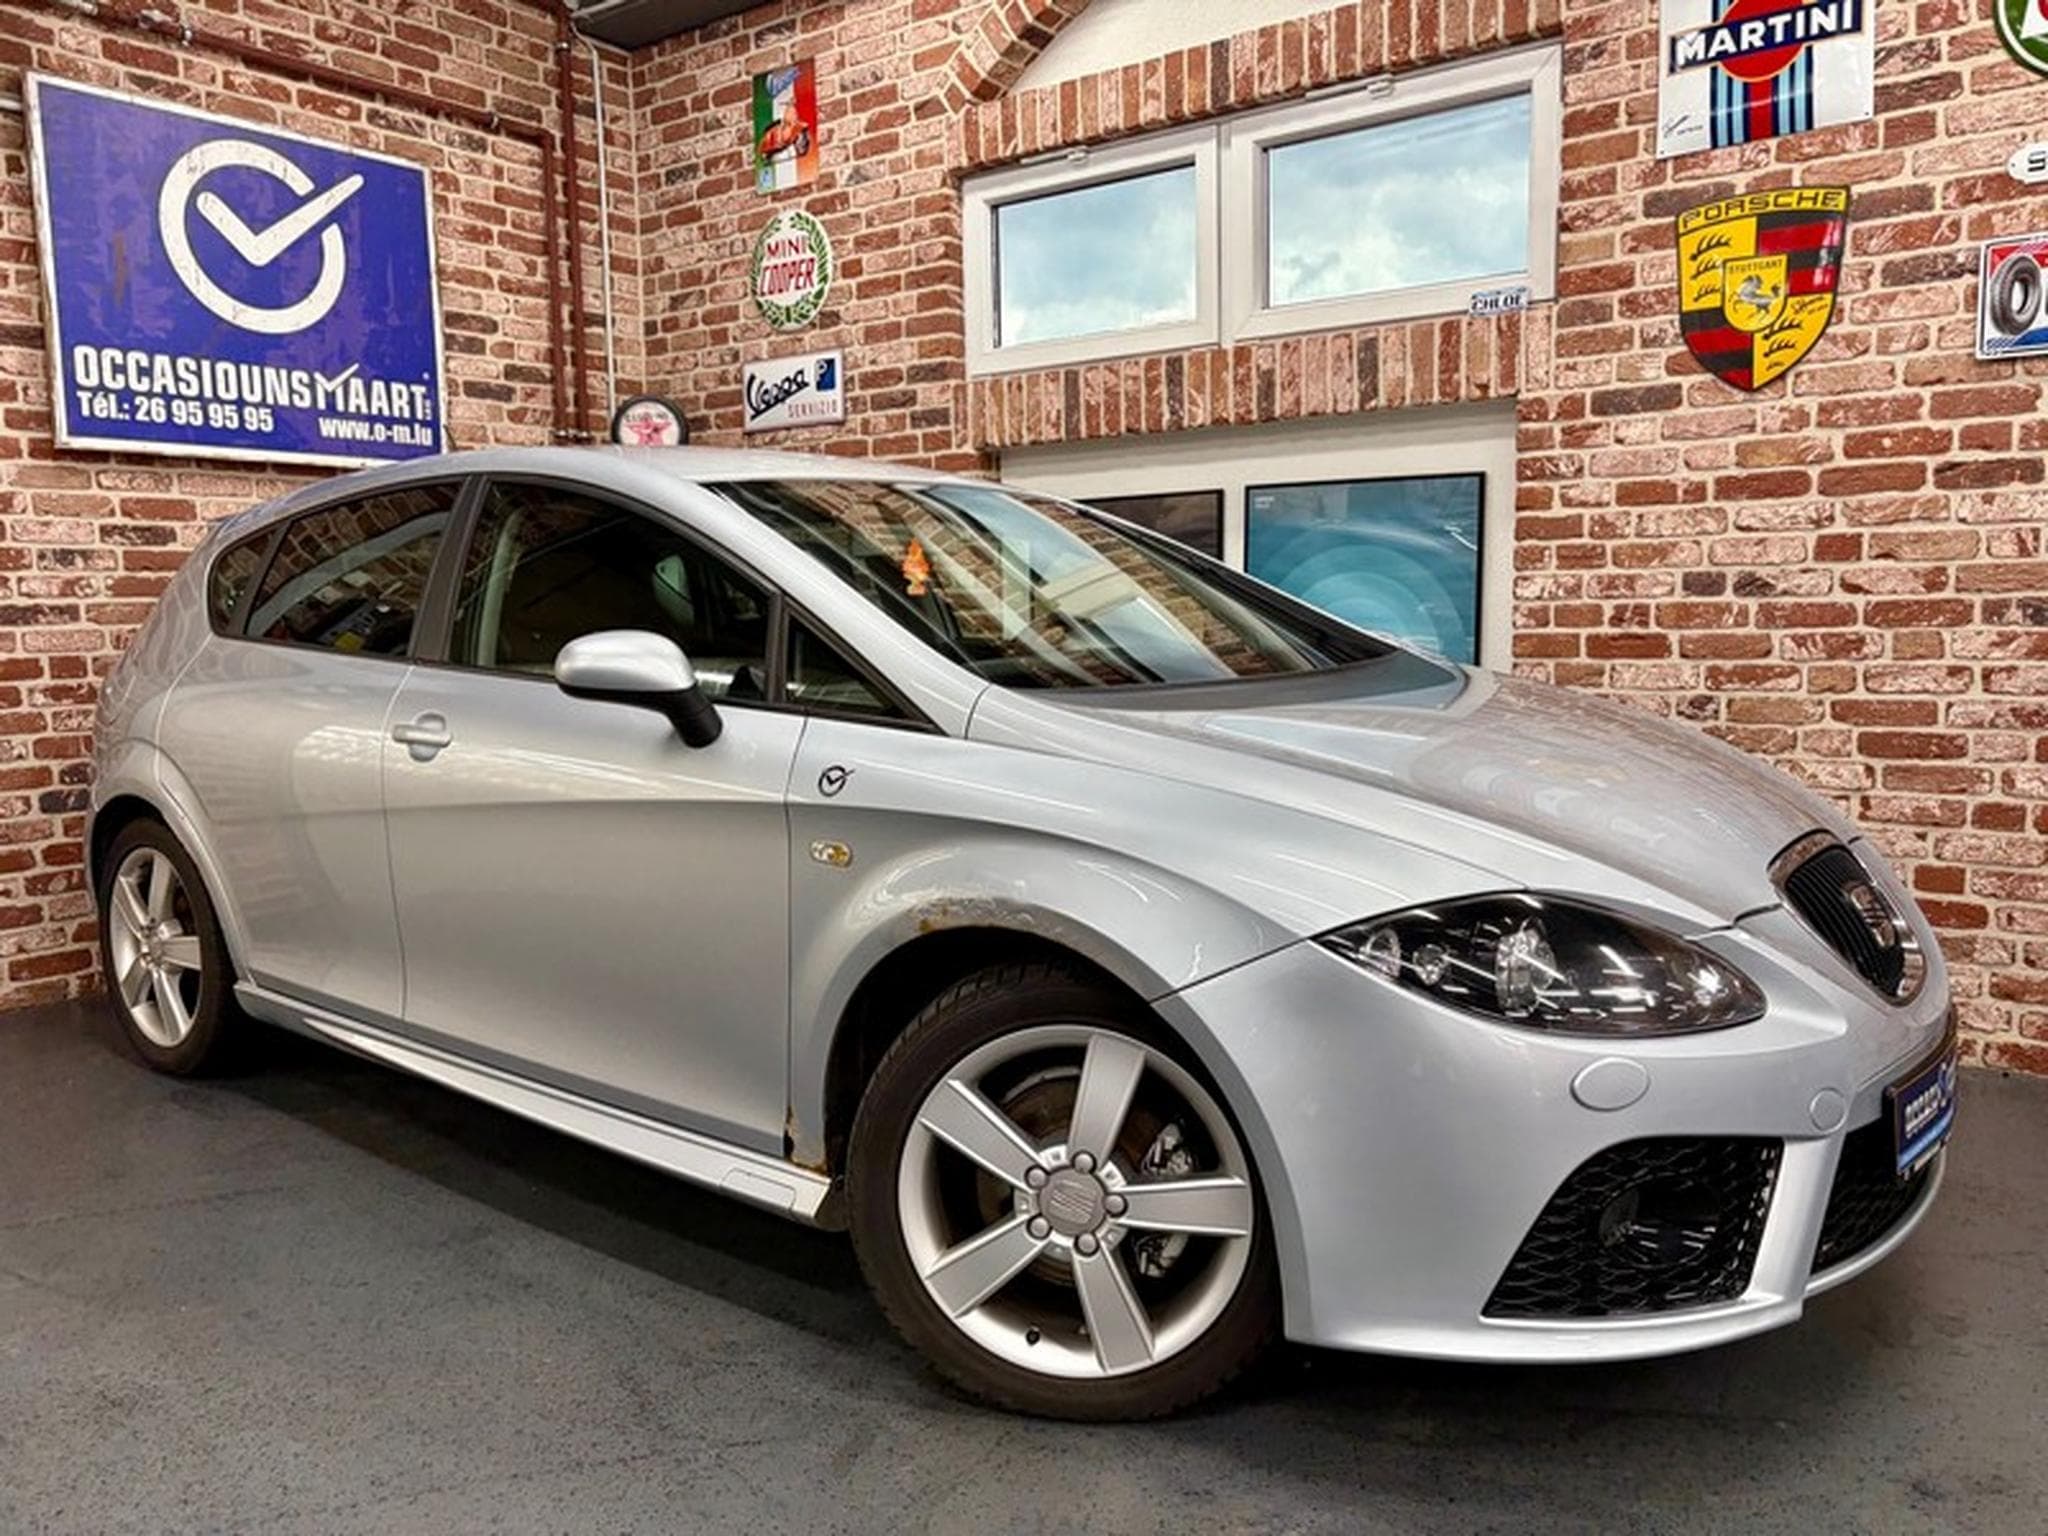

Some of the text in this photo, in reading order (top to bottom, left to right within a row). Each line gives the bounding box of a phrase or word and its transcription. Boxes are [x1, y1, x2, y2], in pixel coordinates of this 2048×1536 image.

[1675, 1, 1853, 67] MARTINI
[1683, 191, 1843, 229] PORSCHE
[767, 236, 807, 257] MINI
[760, 258, 815, 296] COOPER
[134, 396, 167, 424] 26
[171, 400, 204, 427] 95
[208, 403, 240, 430] 95
[243, 406, 275, 433] 95
[318, 417, 433, 446] www.o-m.lu
